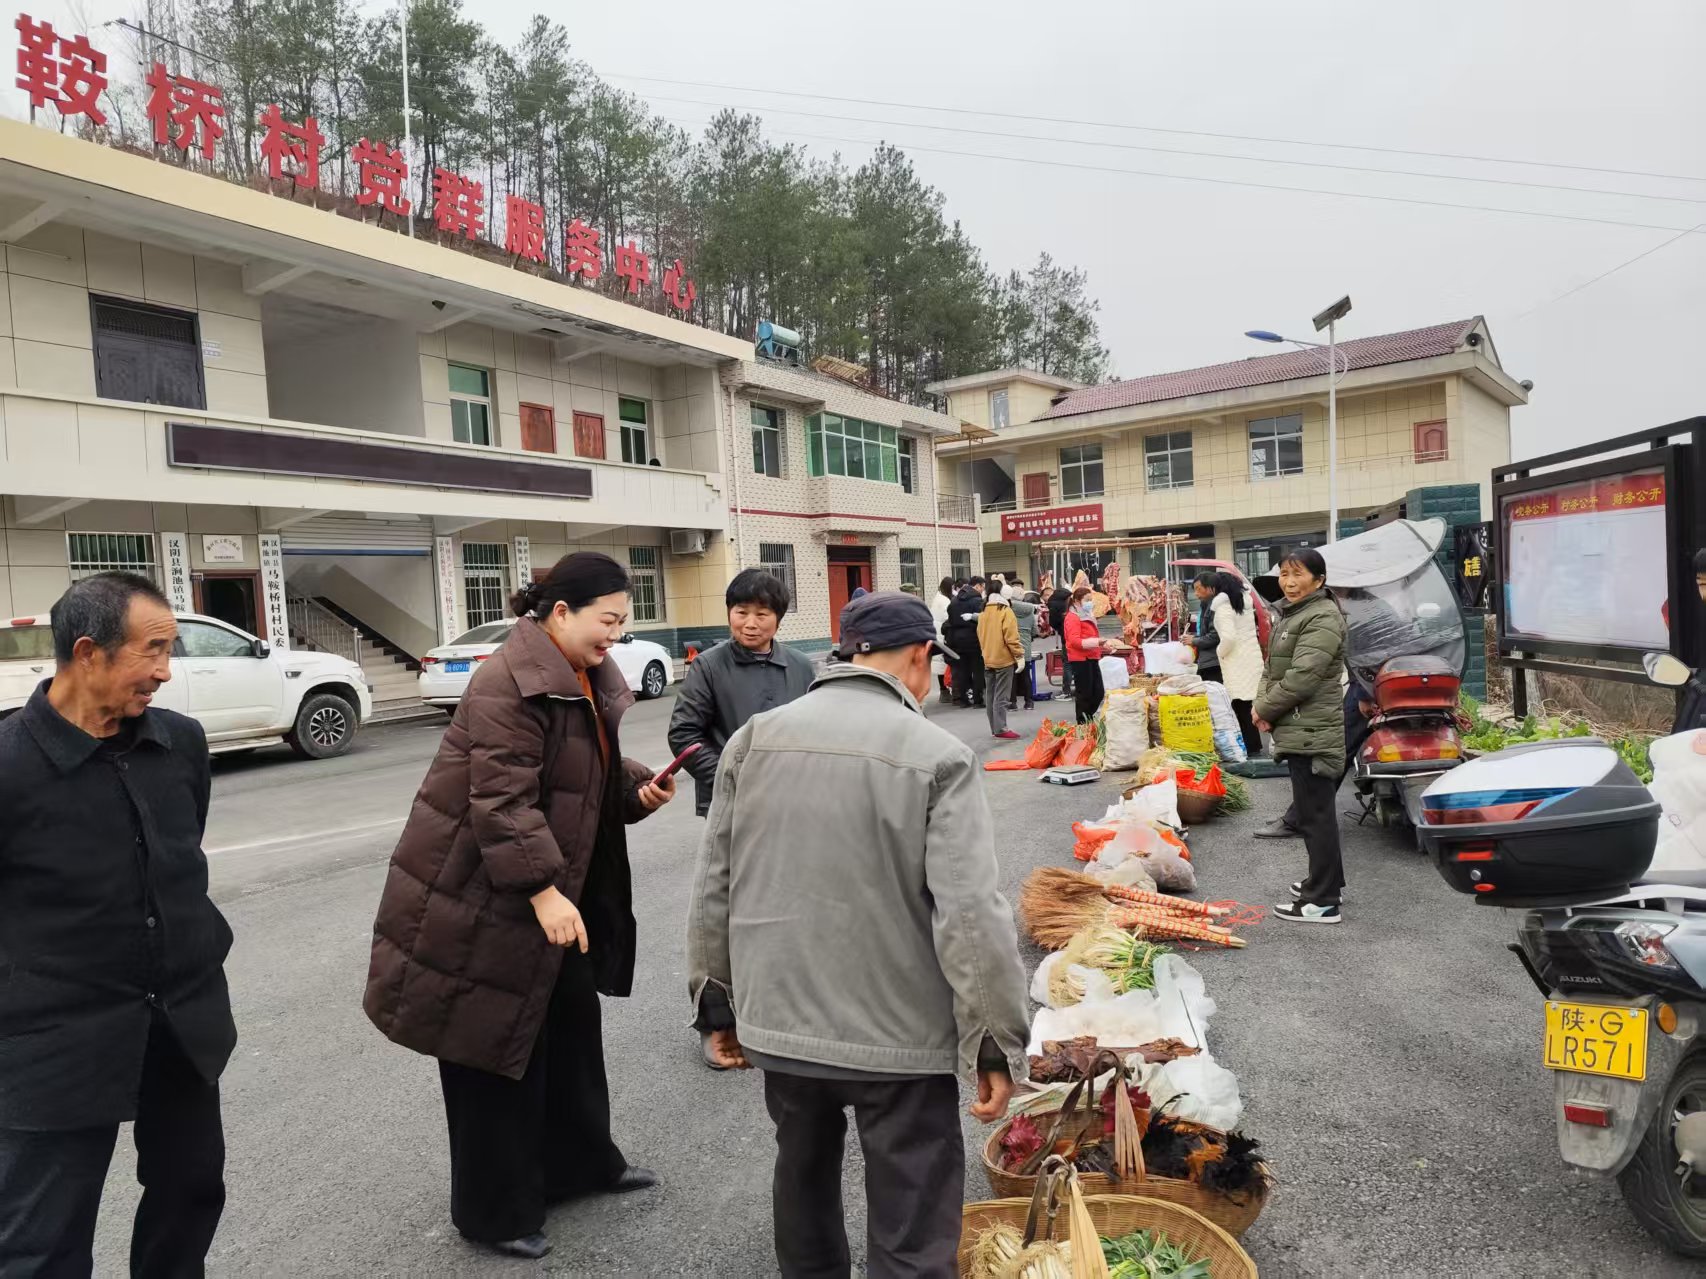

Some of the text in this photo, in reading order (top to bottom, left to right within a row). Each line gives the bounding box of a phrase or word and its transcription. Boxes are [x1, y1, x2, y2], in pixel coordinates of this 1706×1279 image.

[15, 14, 695, 310] 鞍桥村党群服务中心
[1612, 487, 1662, 506] 财务公开
[1560, 975, 1602, 984] SUZUKI
[1548, 1034, 1632, 1074] LR571
